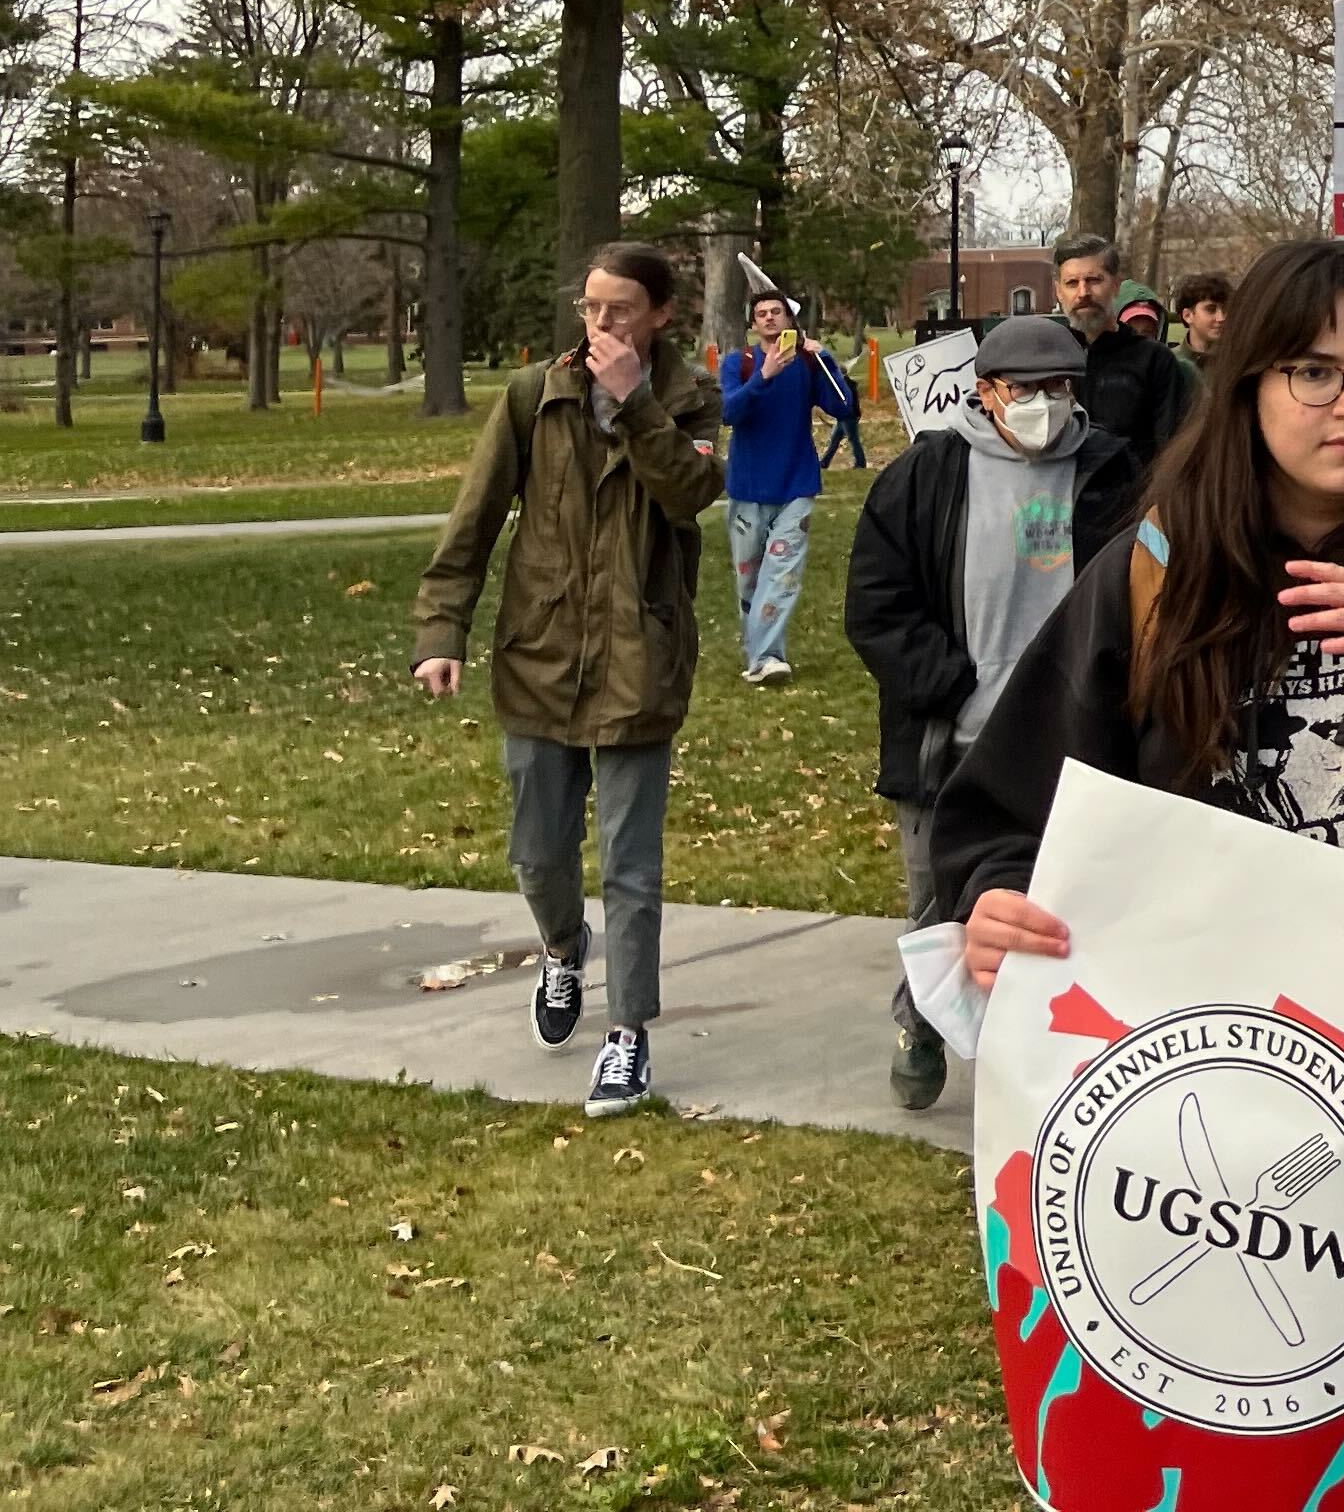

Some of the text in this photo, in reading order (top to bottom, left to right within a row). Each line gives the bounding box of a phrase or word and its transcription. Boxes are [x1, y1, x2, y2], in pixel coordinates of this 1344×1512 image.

[1074, 1025, 1217, 1127] GRINNELL
[1051, 1132, 1077, 1175] OF
[1046, 1186, 1084, 1300] UNION
[1110, 1345, 1301, 1418] EST 2016
